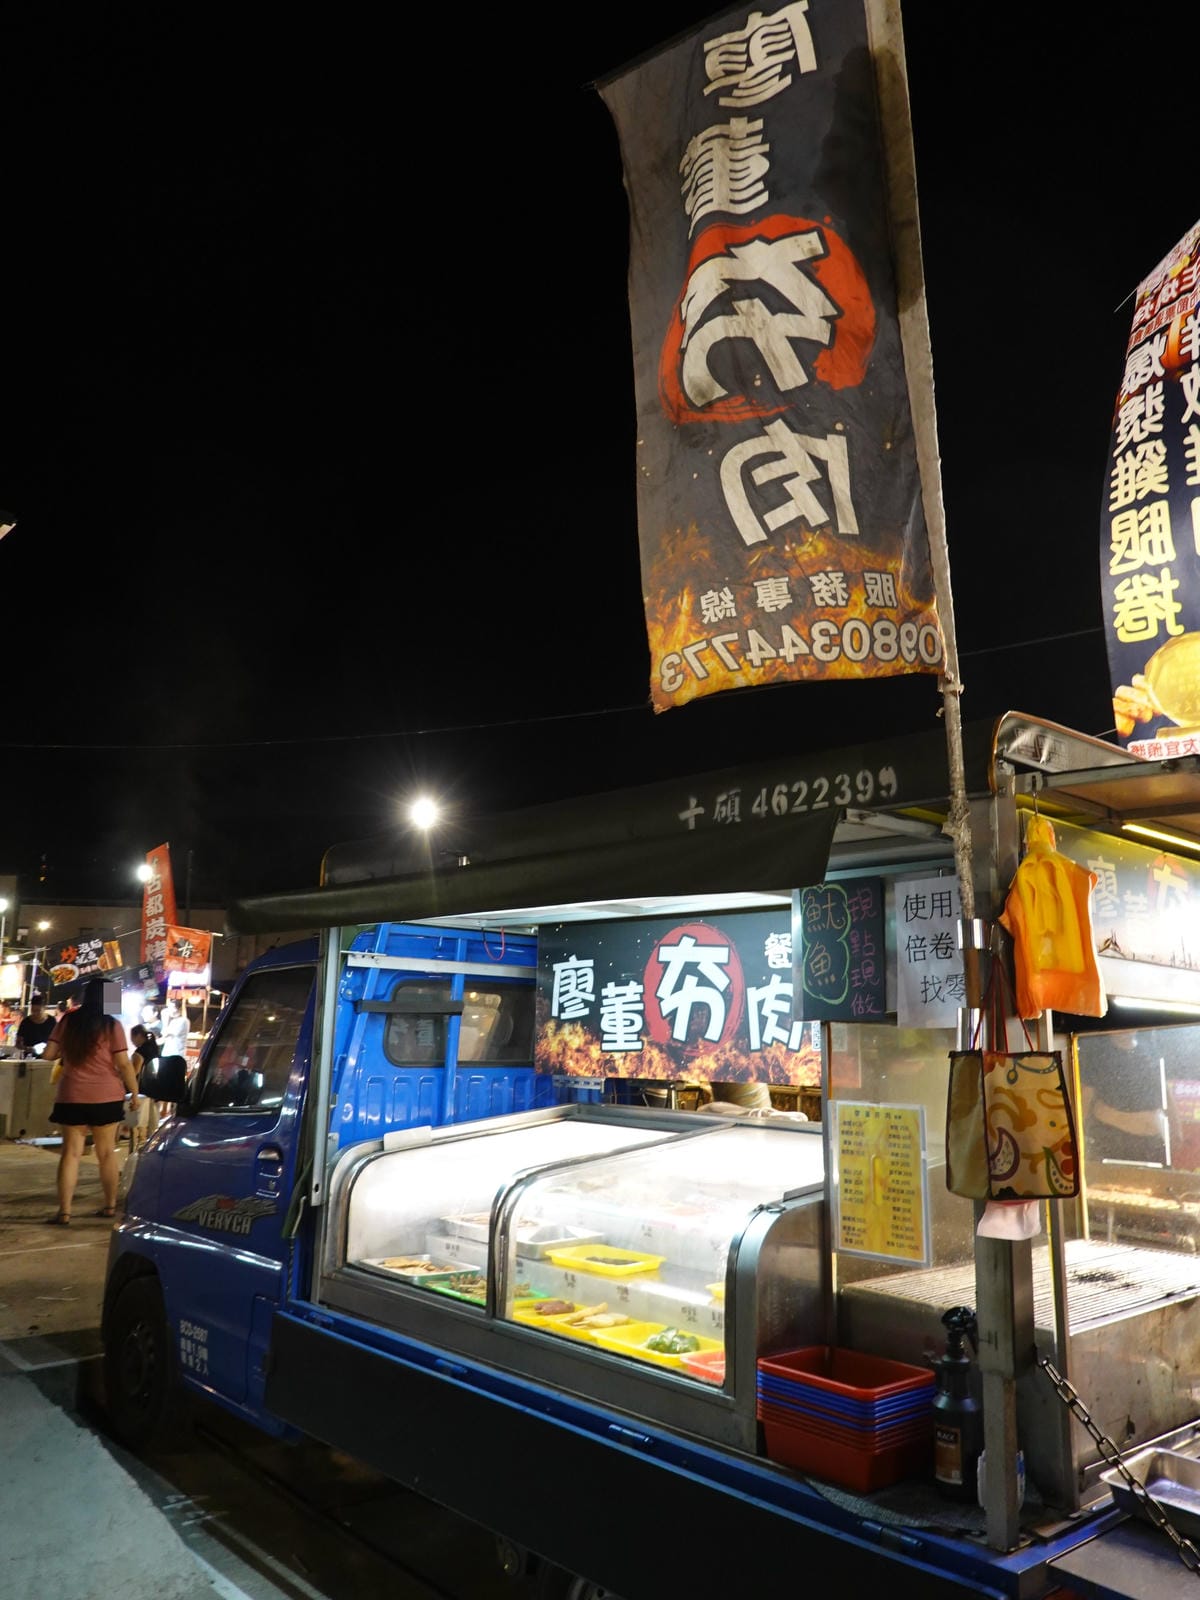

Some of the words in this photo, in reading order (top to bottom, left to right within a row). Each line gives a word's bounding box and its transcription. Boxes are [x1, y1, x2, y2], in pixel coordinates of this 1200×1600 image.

[752, 766, 898, 817] 4622399
[903, 890, 961, 922] 使用
[552, 935, 804, 1051] 廖董夯肉
